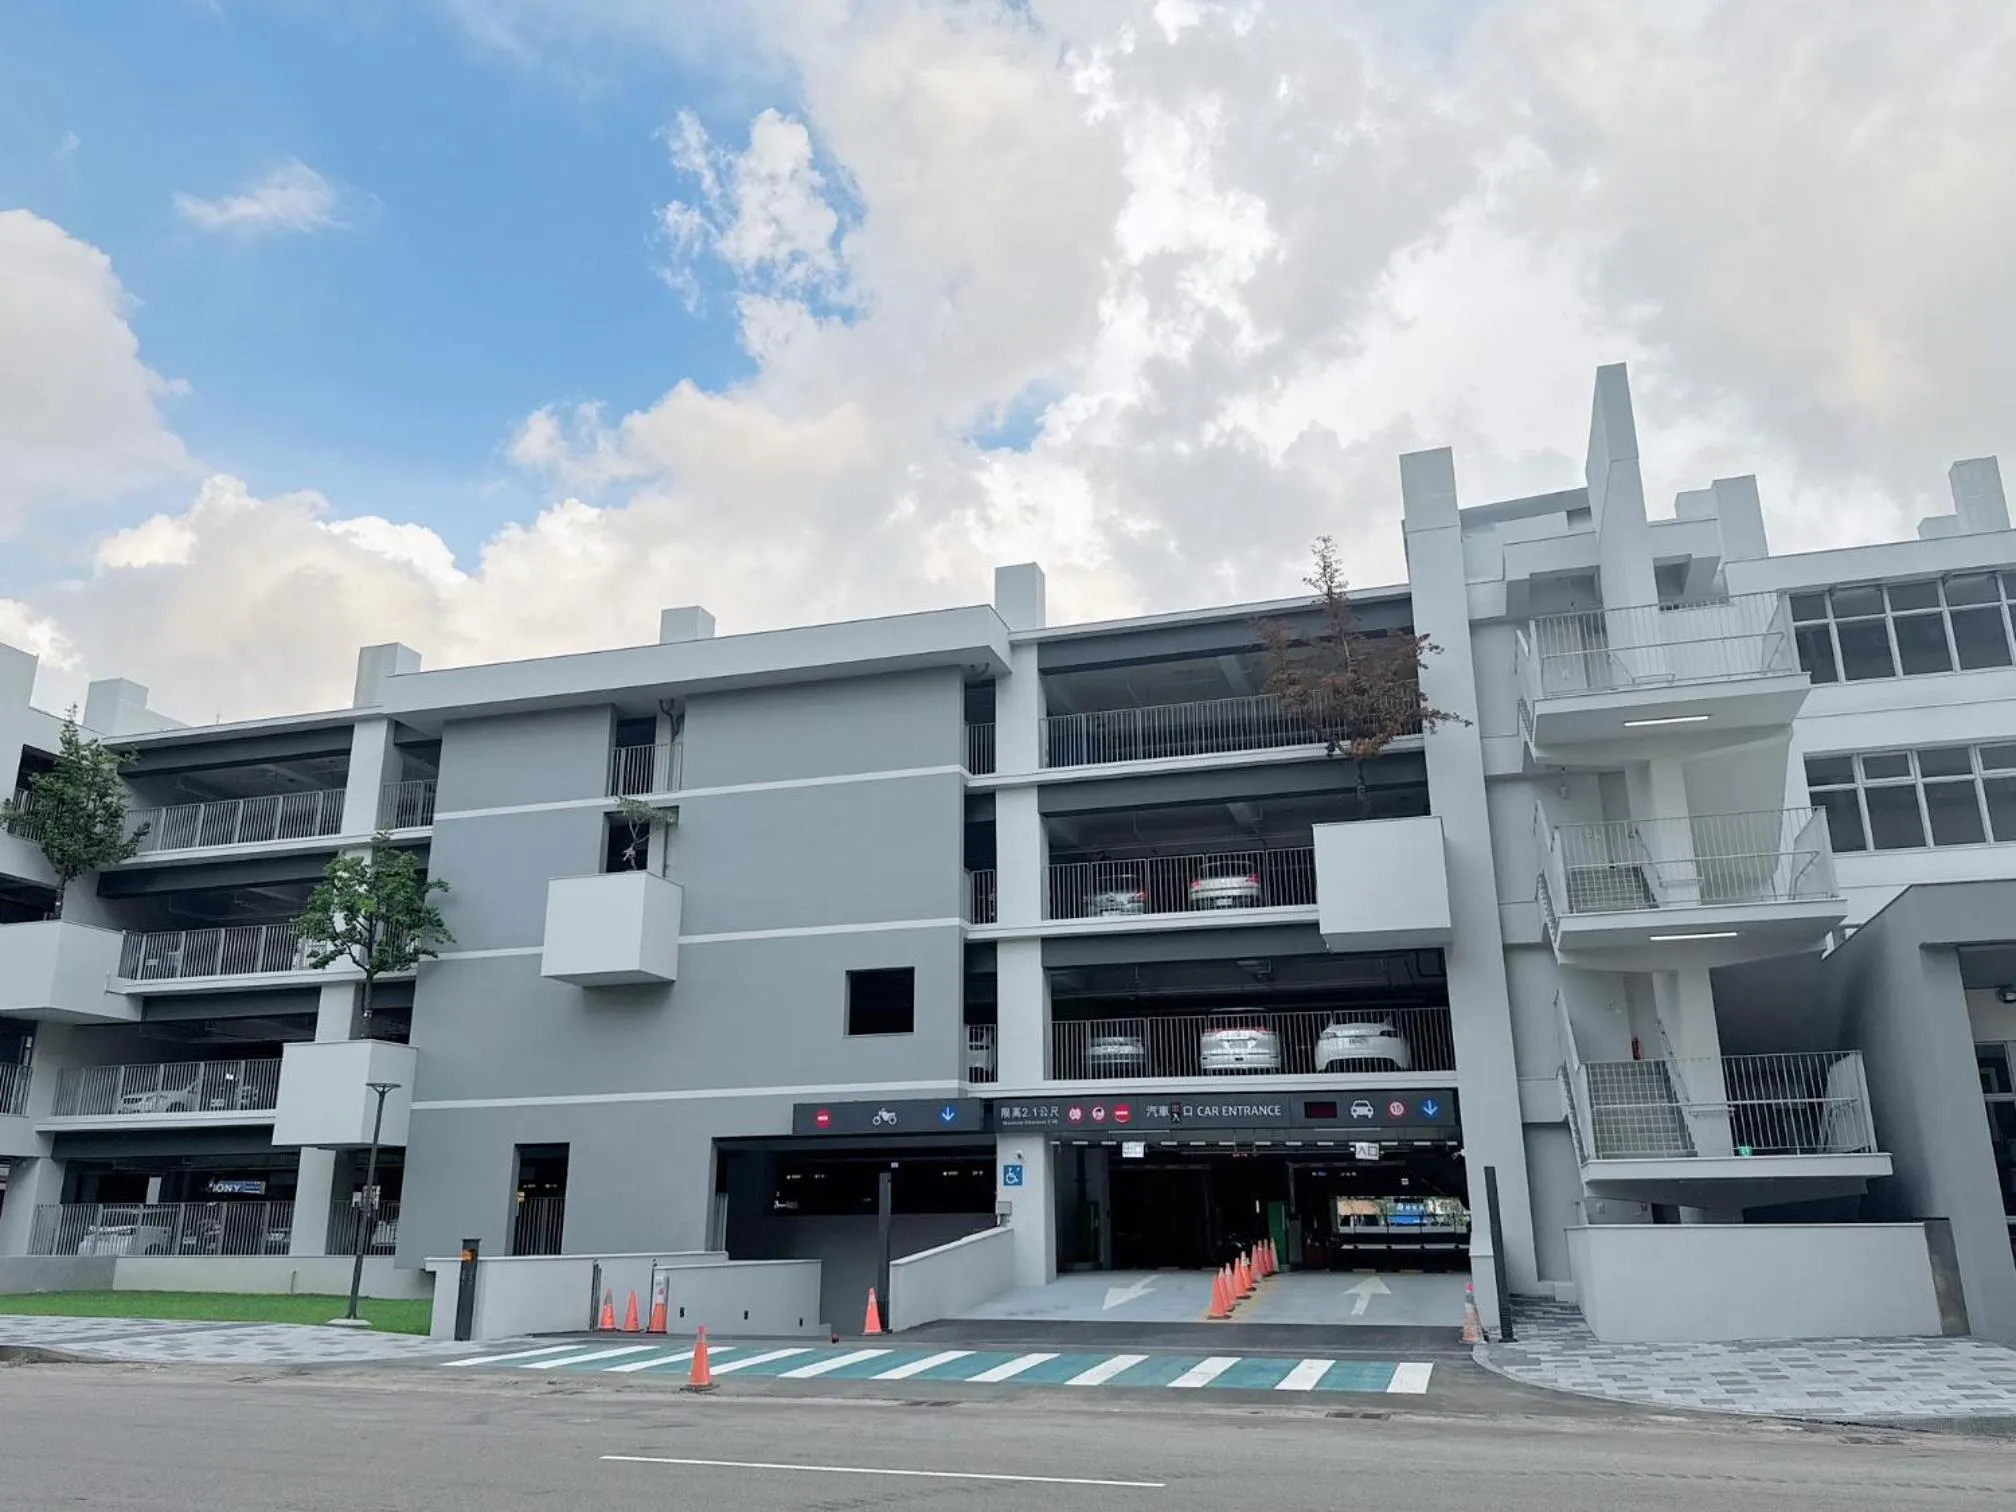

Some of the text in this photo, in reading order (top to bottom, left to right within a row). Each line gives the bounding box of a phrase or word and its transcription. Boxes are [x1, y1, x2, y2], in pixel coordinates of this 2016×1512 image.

[1197, 1105, 1218, 1116] CAR
[1222, 1105, 1281, 1116] ENTRANCE
[1357, 1145, 1378, 1157] 入口
